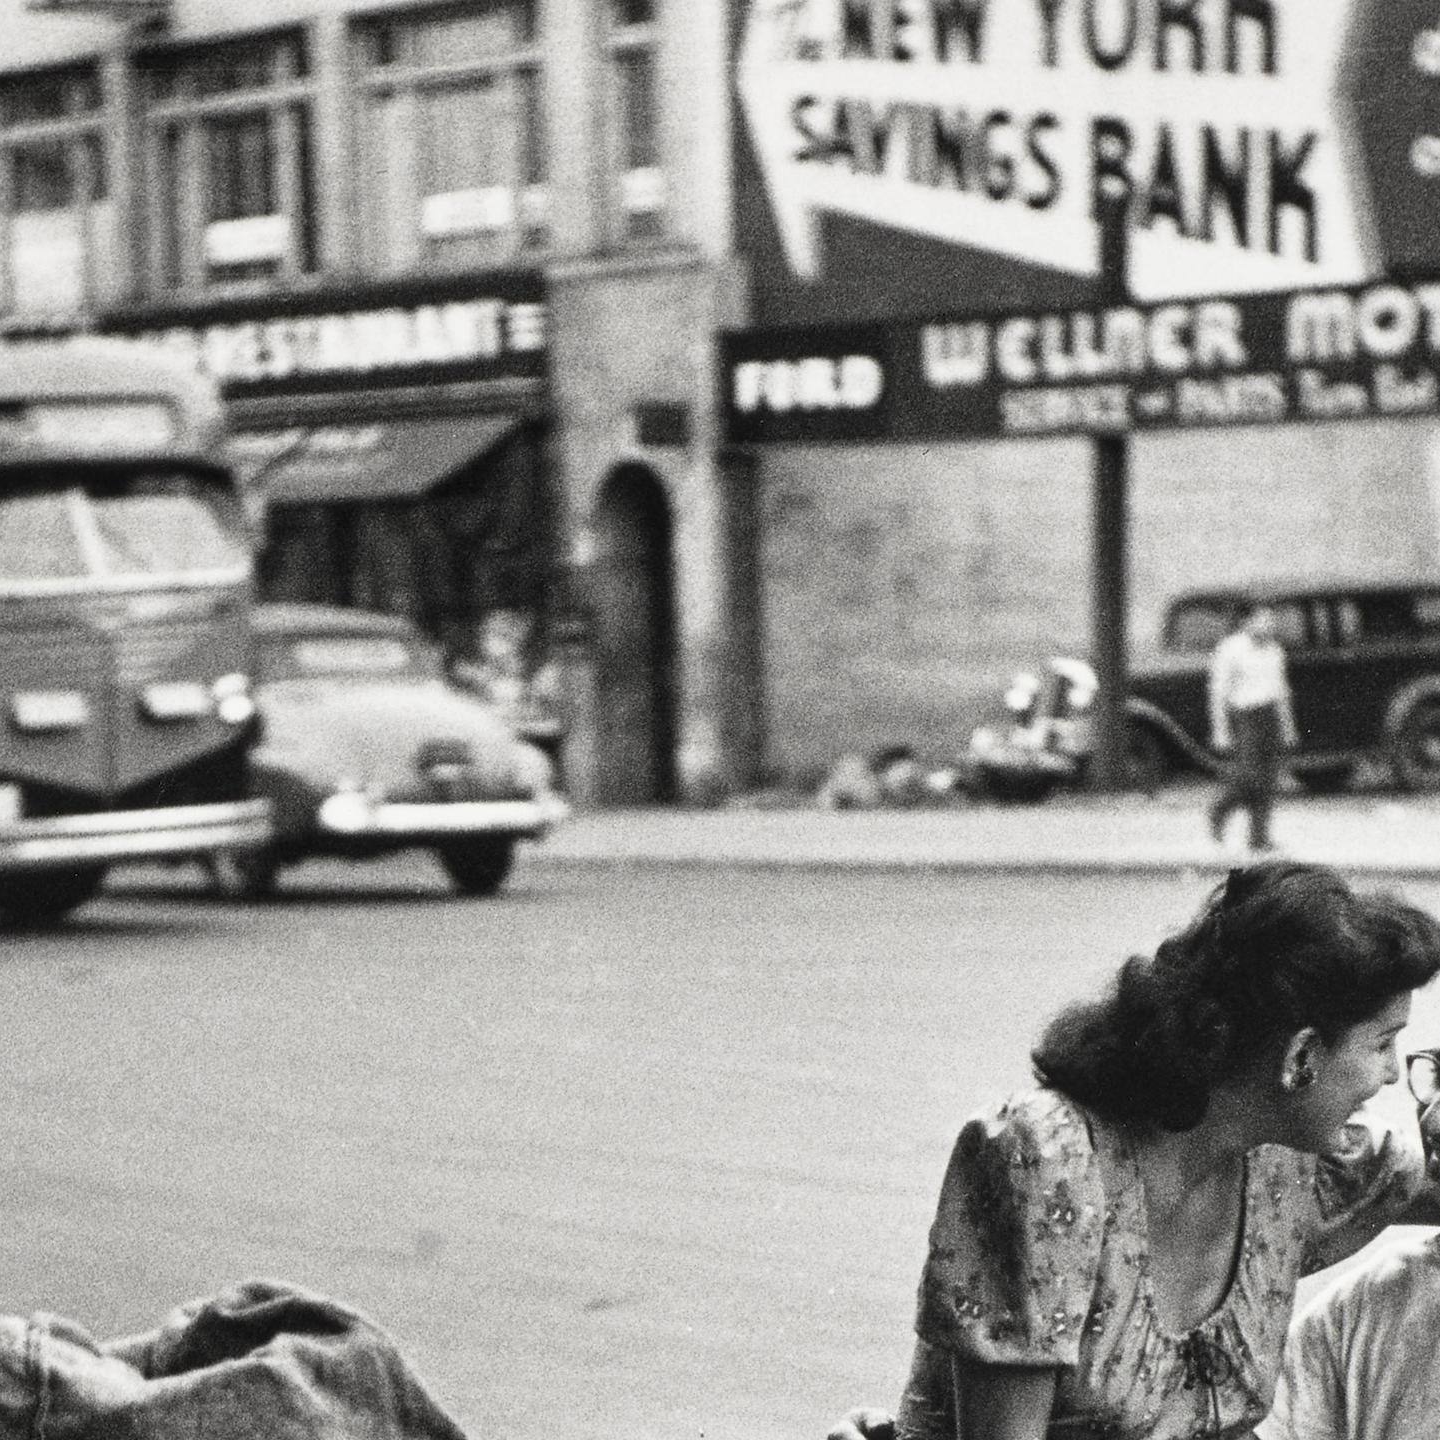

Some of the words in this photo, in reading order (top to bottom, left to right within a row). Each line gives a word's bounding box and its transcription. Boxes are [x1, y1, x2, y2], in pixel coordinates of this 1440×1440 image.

[839, 0, 983, 62] NEW
[1035, 0, 1275, 73] YORK
[792, 95, 1061, 210] SAVINGS
[1091, 115, 1319, 265] BANK
[733, 355, 883, 412] FORD
